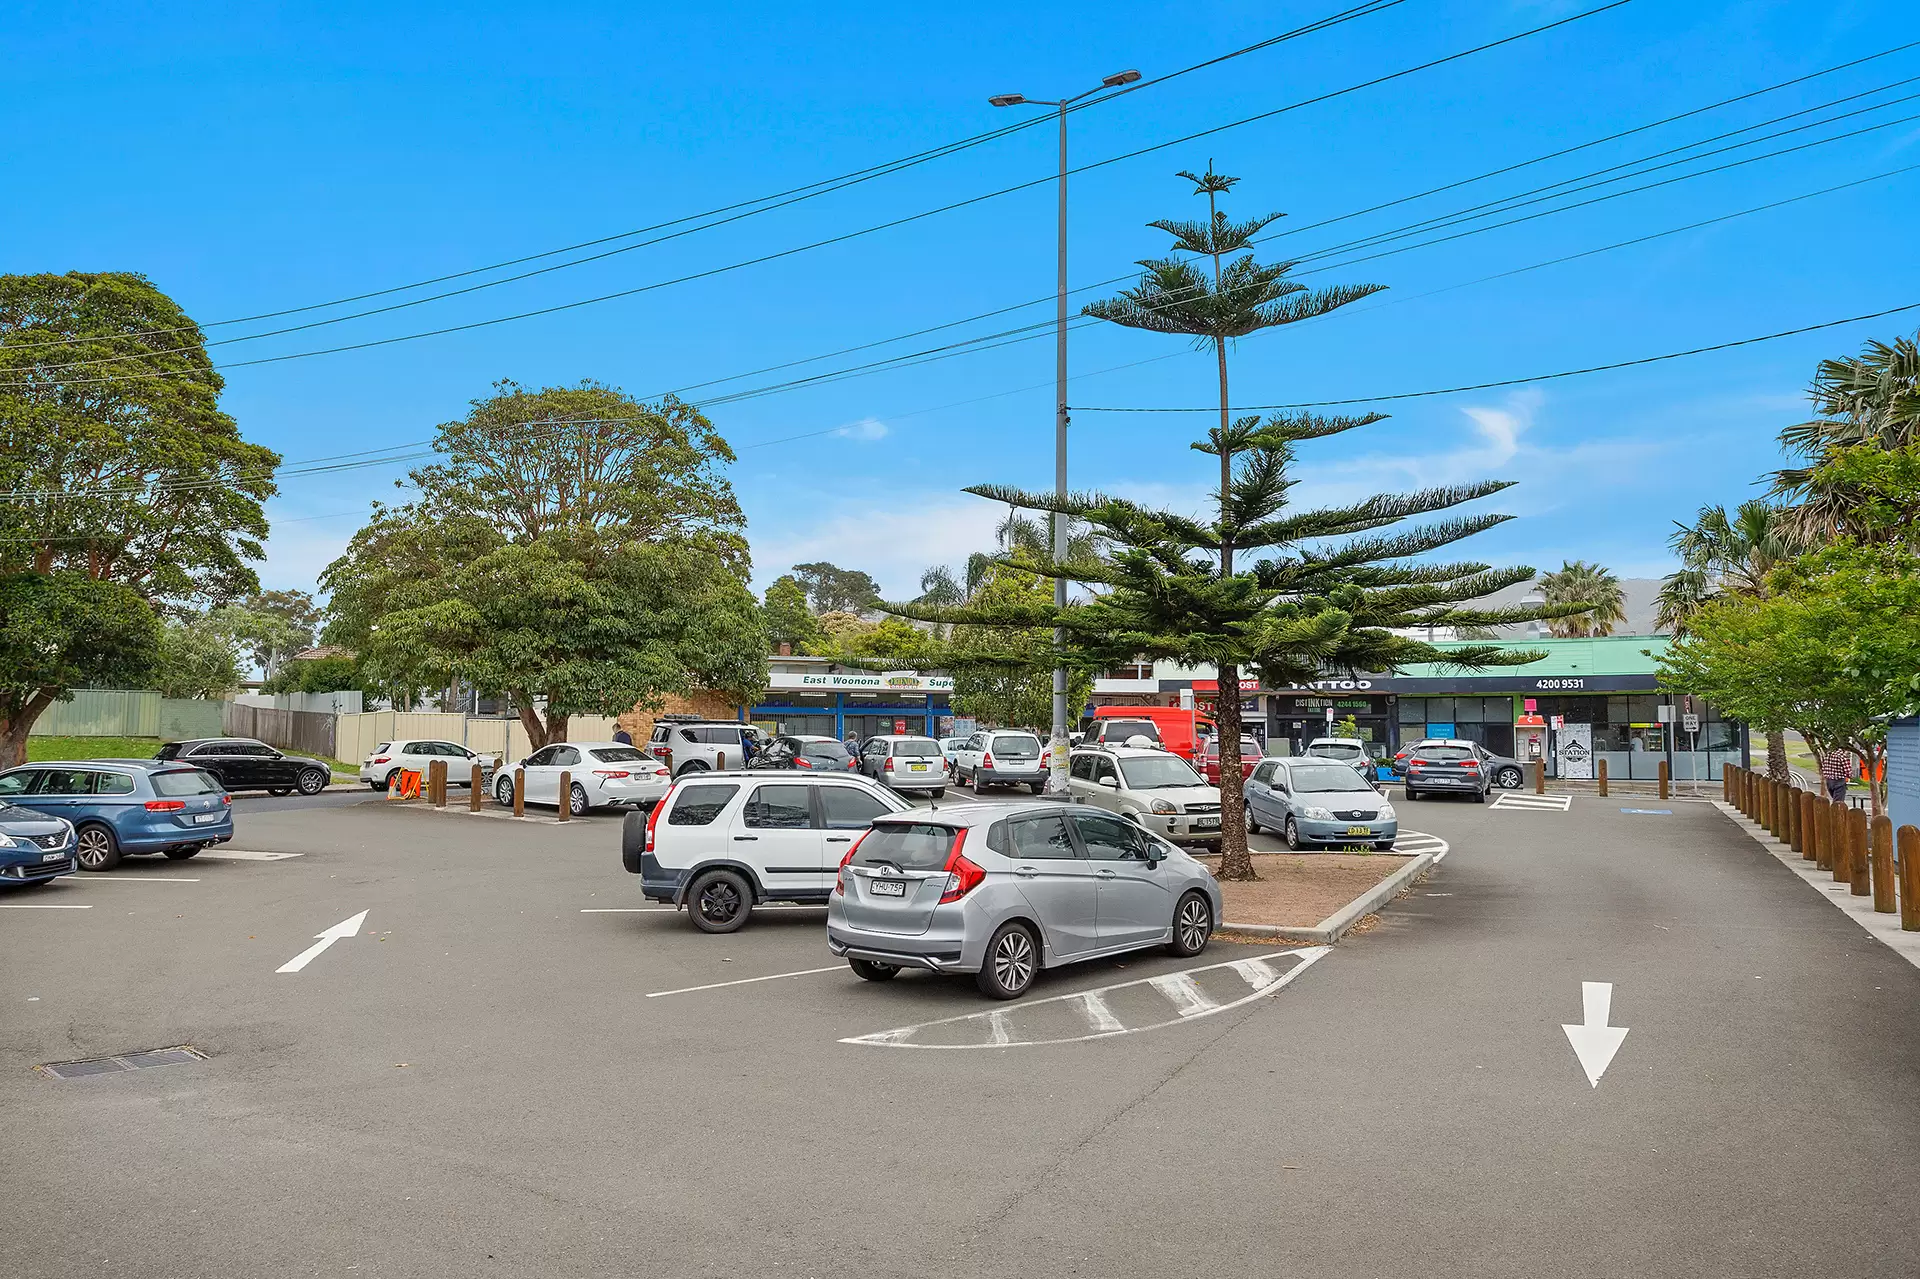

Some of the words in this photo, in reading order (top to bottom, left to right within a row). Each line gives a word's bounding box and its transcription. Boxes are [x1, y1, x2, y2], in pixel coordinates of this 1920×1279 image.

[803, 676, 827, 684] East
[833, 677, 880, 686] Woonona
[929, 678, 955, 689] Supe
[1238, 681, 1258, 689] OST
[1287, 680, 1372, 690] TATTOO
[1536, 679, 1560, 689] 4200
[1561, 678, 1584, 688] 9531
